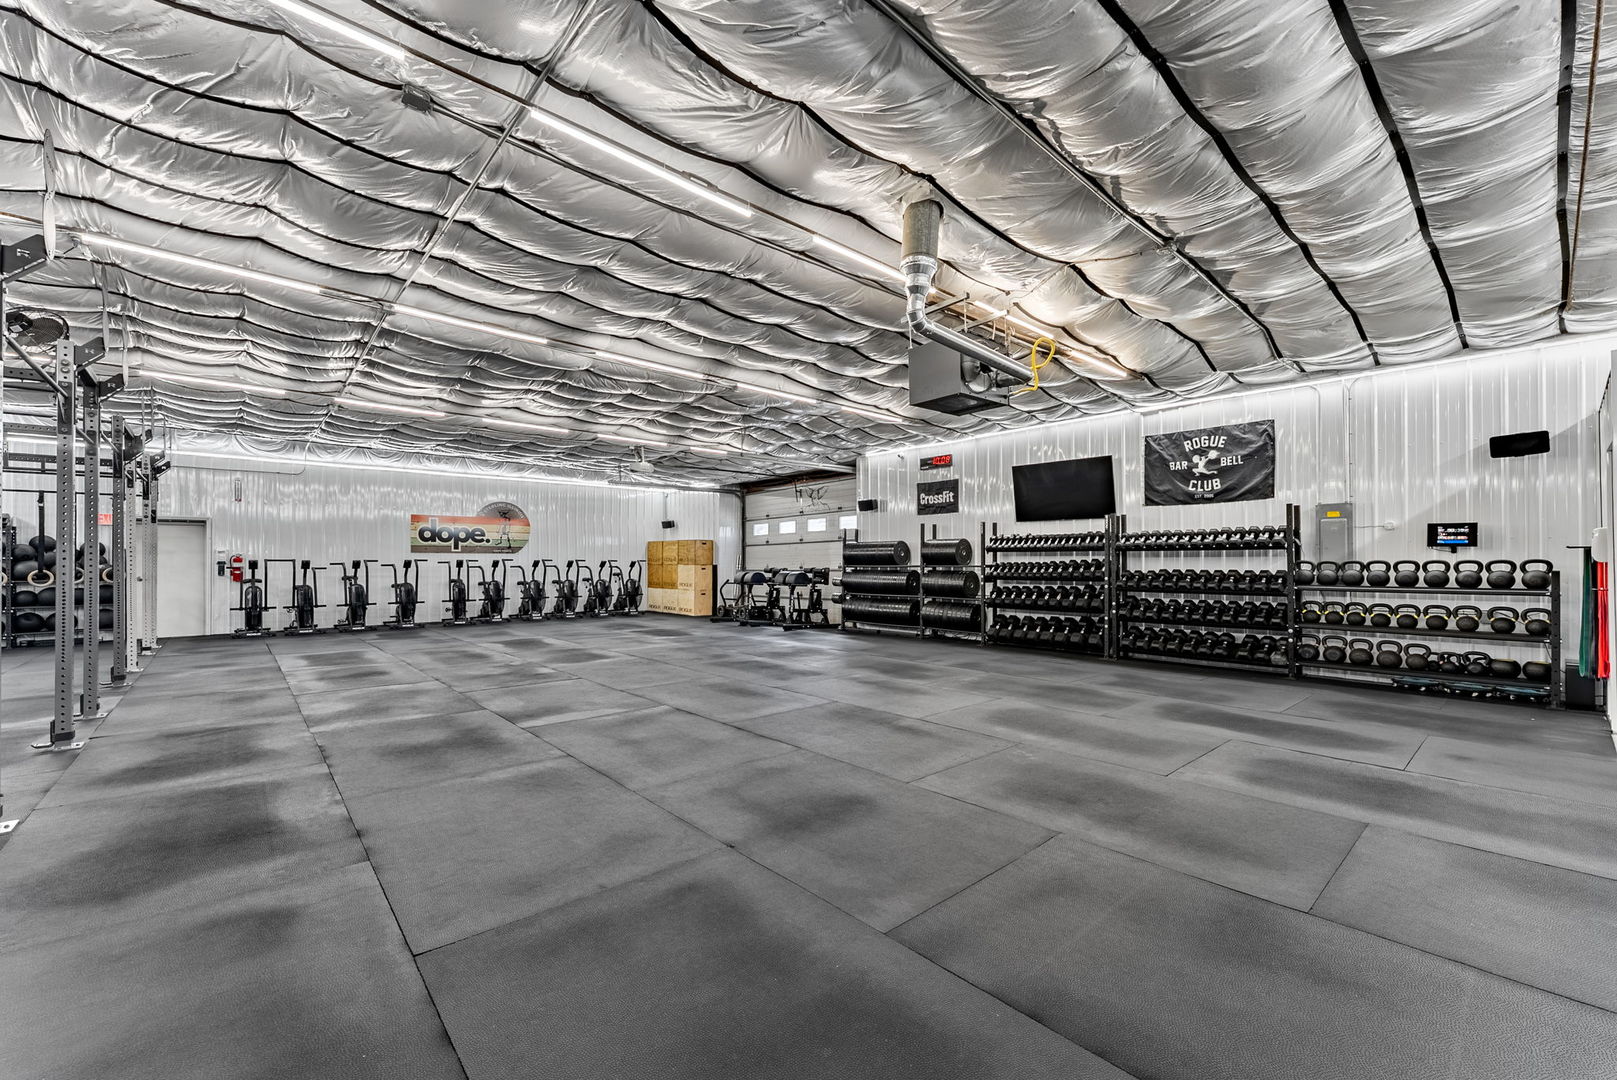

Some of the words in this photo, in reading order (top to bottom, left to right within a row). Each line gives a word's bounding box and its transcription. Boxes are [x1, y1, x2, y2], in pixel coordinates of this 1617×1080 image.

[1184, 436, 1227, 452] ROGUE
[1169, 461, 1188, 471] BAR
[1220, 455, 1244, 467] BELL
[1188, 478, 1221, 492] CLUB
[920, 490, 954, 505] CrossFit
[418, 519, 491, 550] dope.
